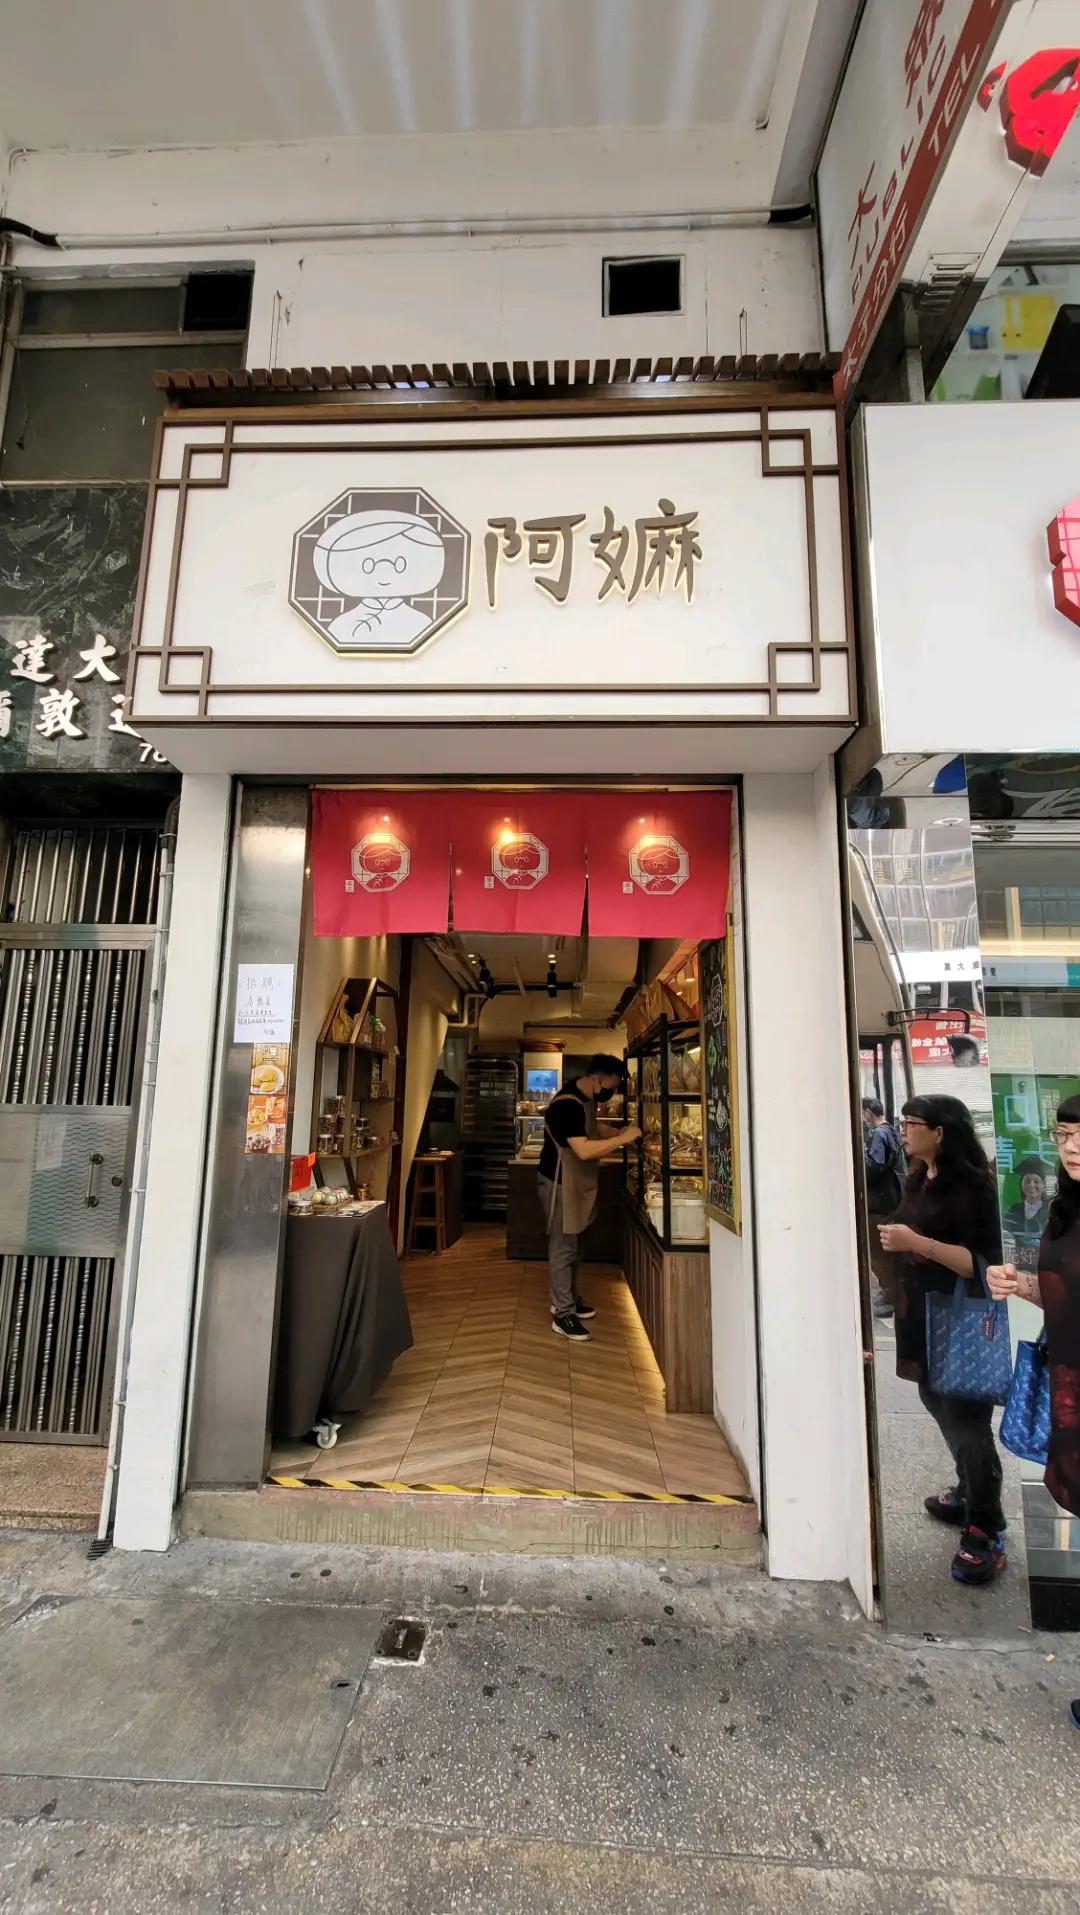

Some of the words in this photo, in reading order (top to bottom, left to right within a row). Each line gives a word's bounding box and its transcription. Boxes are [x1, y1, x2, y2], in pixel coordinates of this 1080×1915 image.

[927, 43, 981, 156] TEL
[852, 34, 946, 306] PUBLIC
[484, 498, 702, 607] 阿嫲
